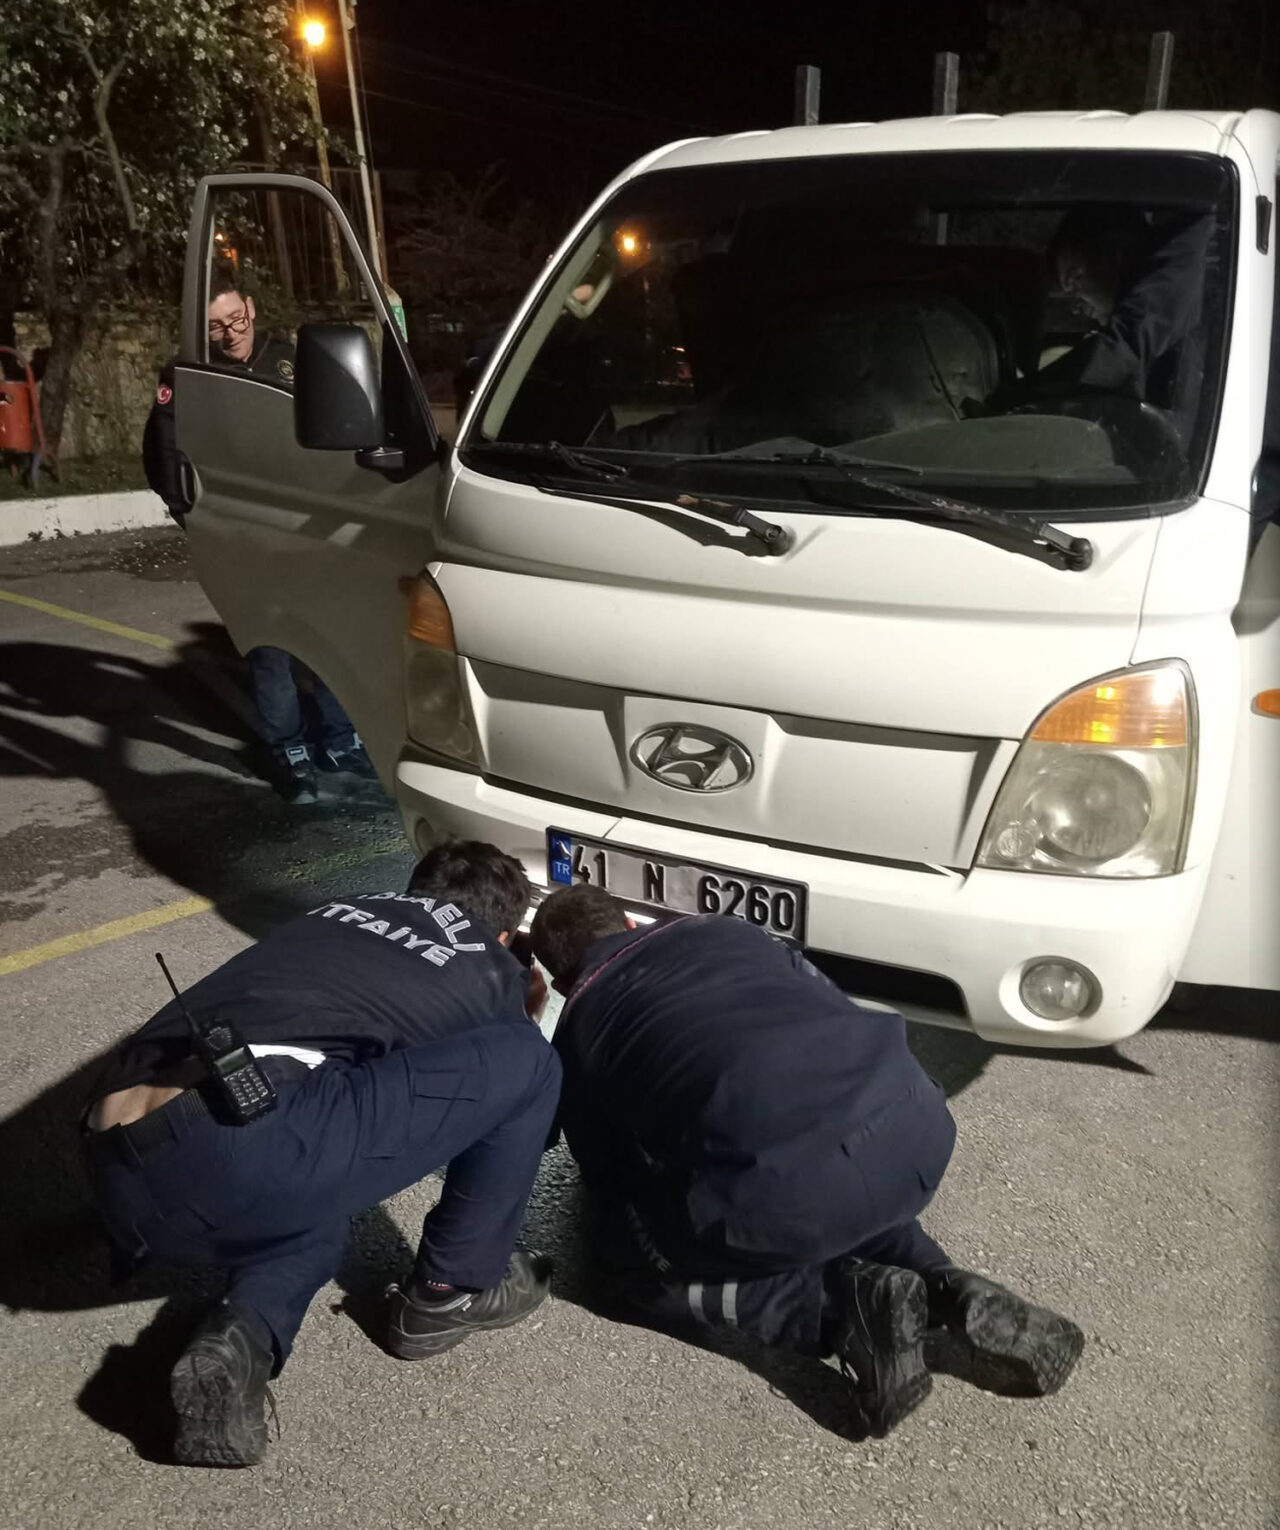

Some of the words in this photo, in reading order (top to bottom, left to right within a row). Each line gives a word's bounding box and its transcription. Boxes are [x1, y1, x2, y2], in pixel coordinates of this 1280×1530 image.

[555, 861, 570, 876] TR
[572, 844, 608, 888] 41
[644, 861, 665, 902] N
[698, 874, 797, 933] 6260
